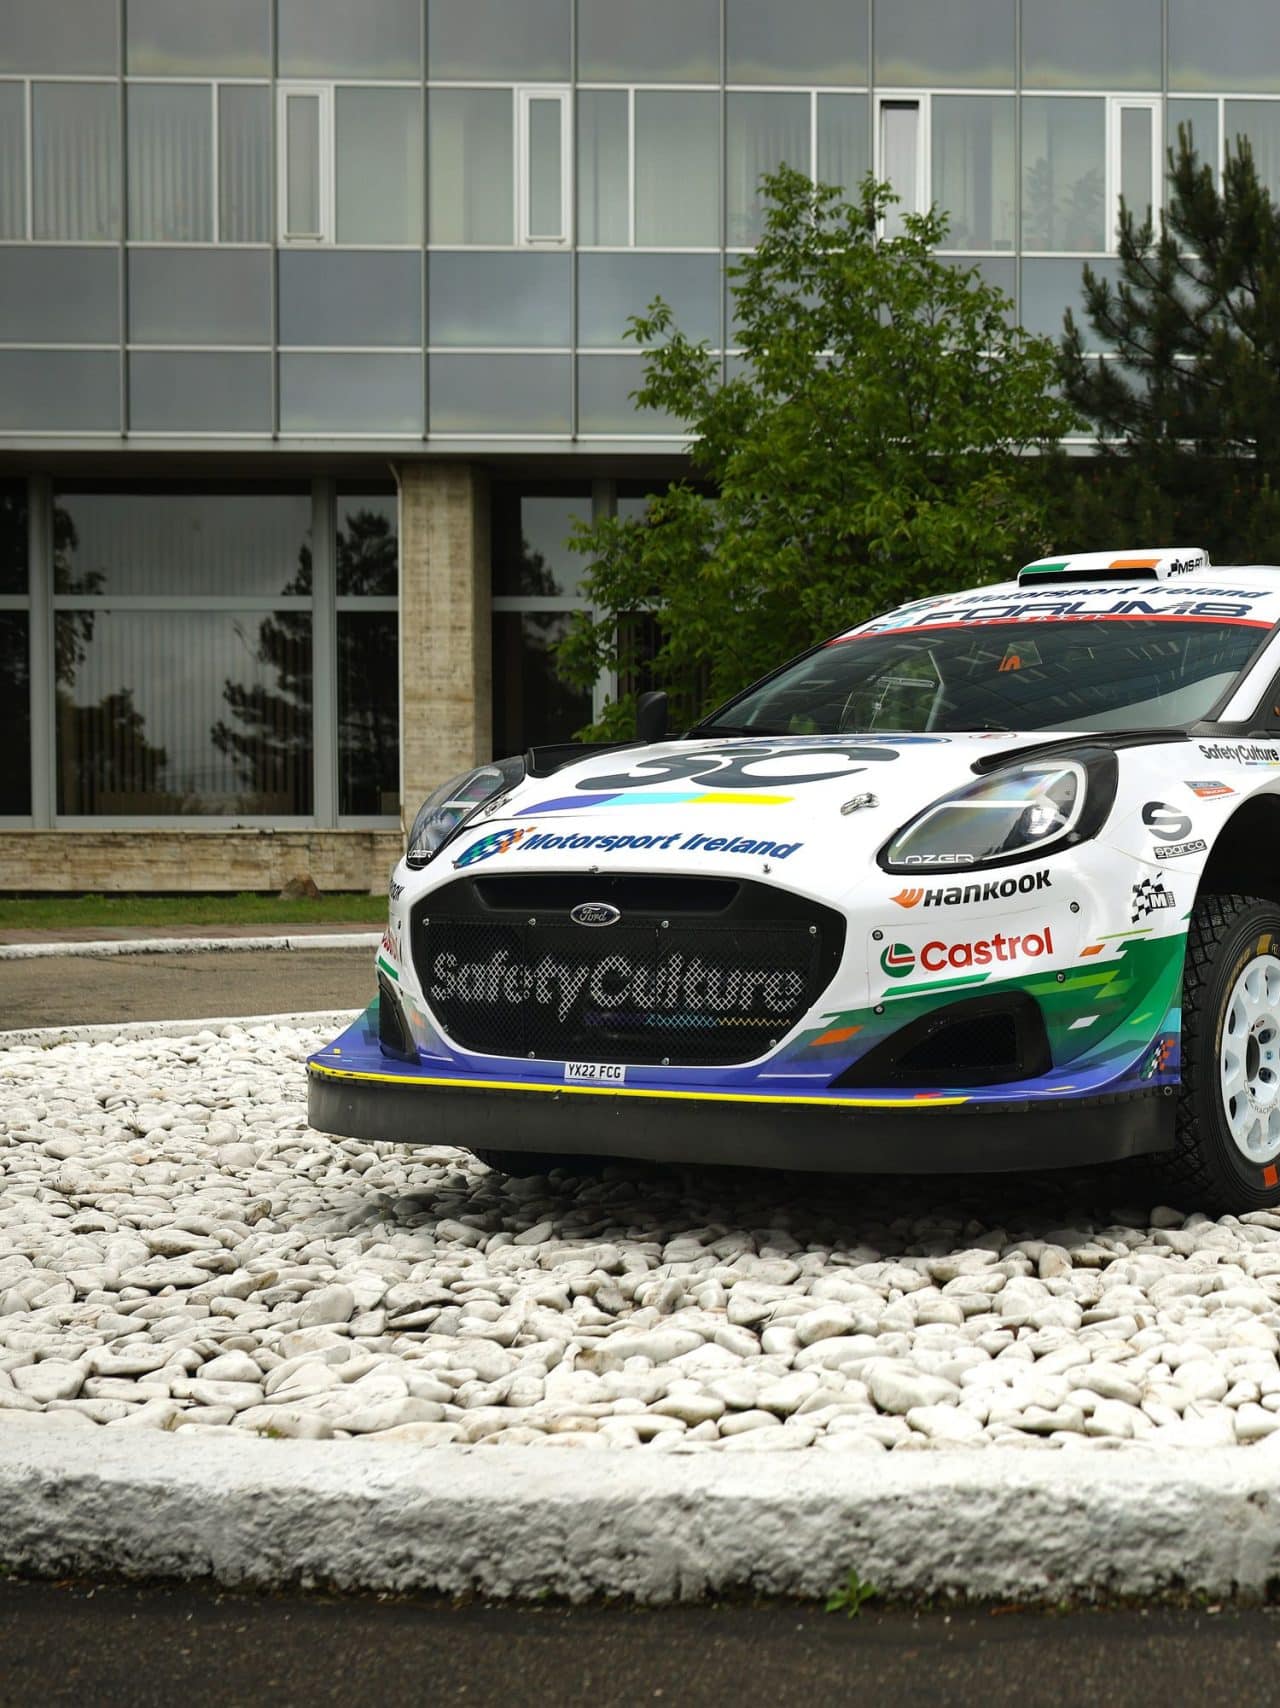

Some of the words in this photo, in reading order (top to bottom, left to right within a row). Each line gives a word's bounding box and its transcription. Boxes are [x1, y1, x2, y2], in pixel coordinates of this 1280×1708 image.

[1141, 585, 1273, 599] Ireland
[912, 600, 1254, 626] FORUM8
[1198, 743, 1280, 764] SafetyCulture
[517, 833, 683, 852] Motorsport
[679, 833, 805, 860] Ireland
[1155, 840, 1206, 858] sparco
[579, 905, 609, 922] Ford
[920, 926, 1054, 972] Castrol
[430, 949, 804, 1024] SafetyCulture
[568, 1063, 596, 1078] YX22
[599, 1064, 622, 1079] FCG
